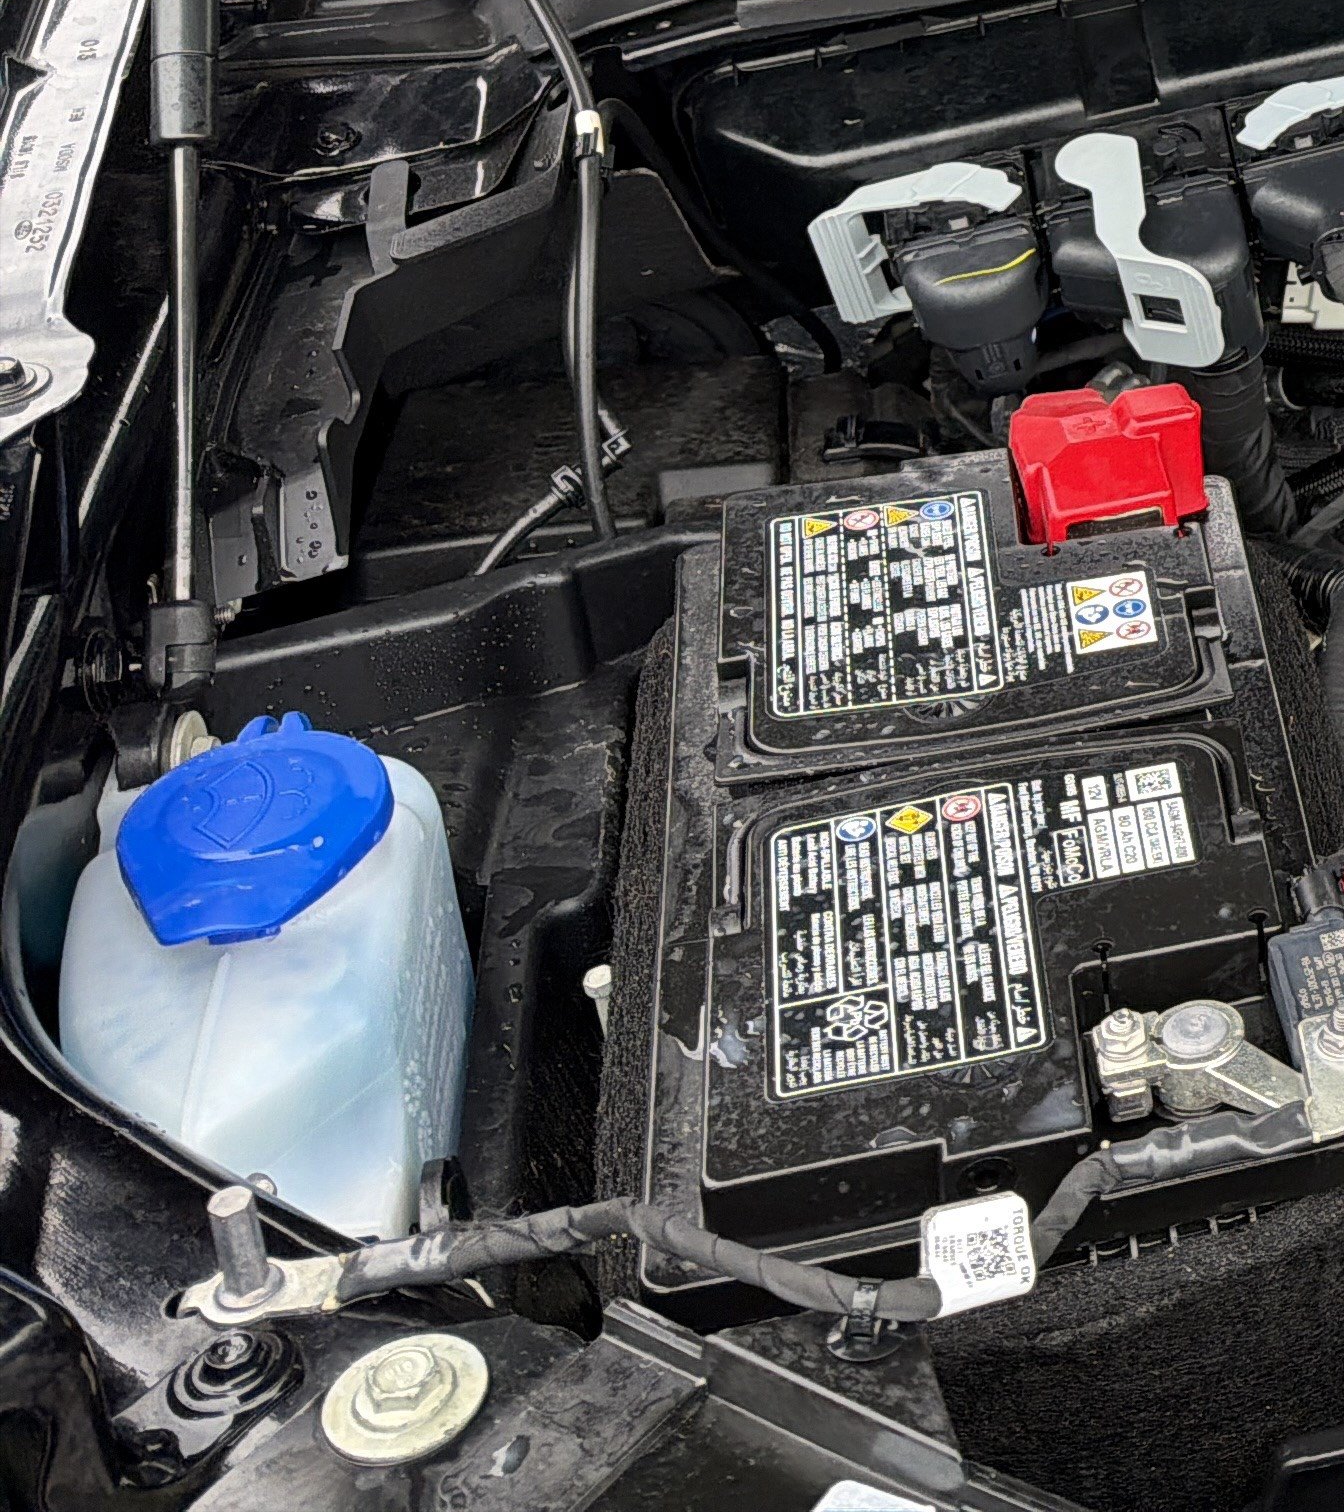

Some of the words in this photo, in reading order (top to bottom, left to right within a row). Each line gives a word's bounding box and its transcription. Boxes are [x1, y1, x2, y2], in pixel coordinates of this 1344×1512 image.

[1059, 829, 1085, 883] FoMoCo
[1011, 1207, 1028, 1261] TORQUE
[1016, 1264, 1032, 1285] OK
